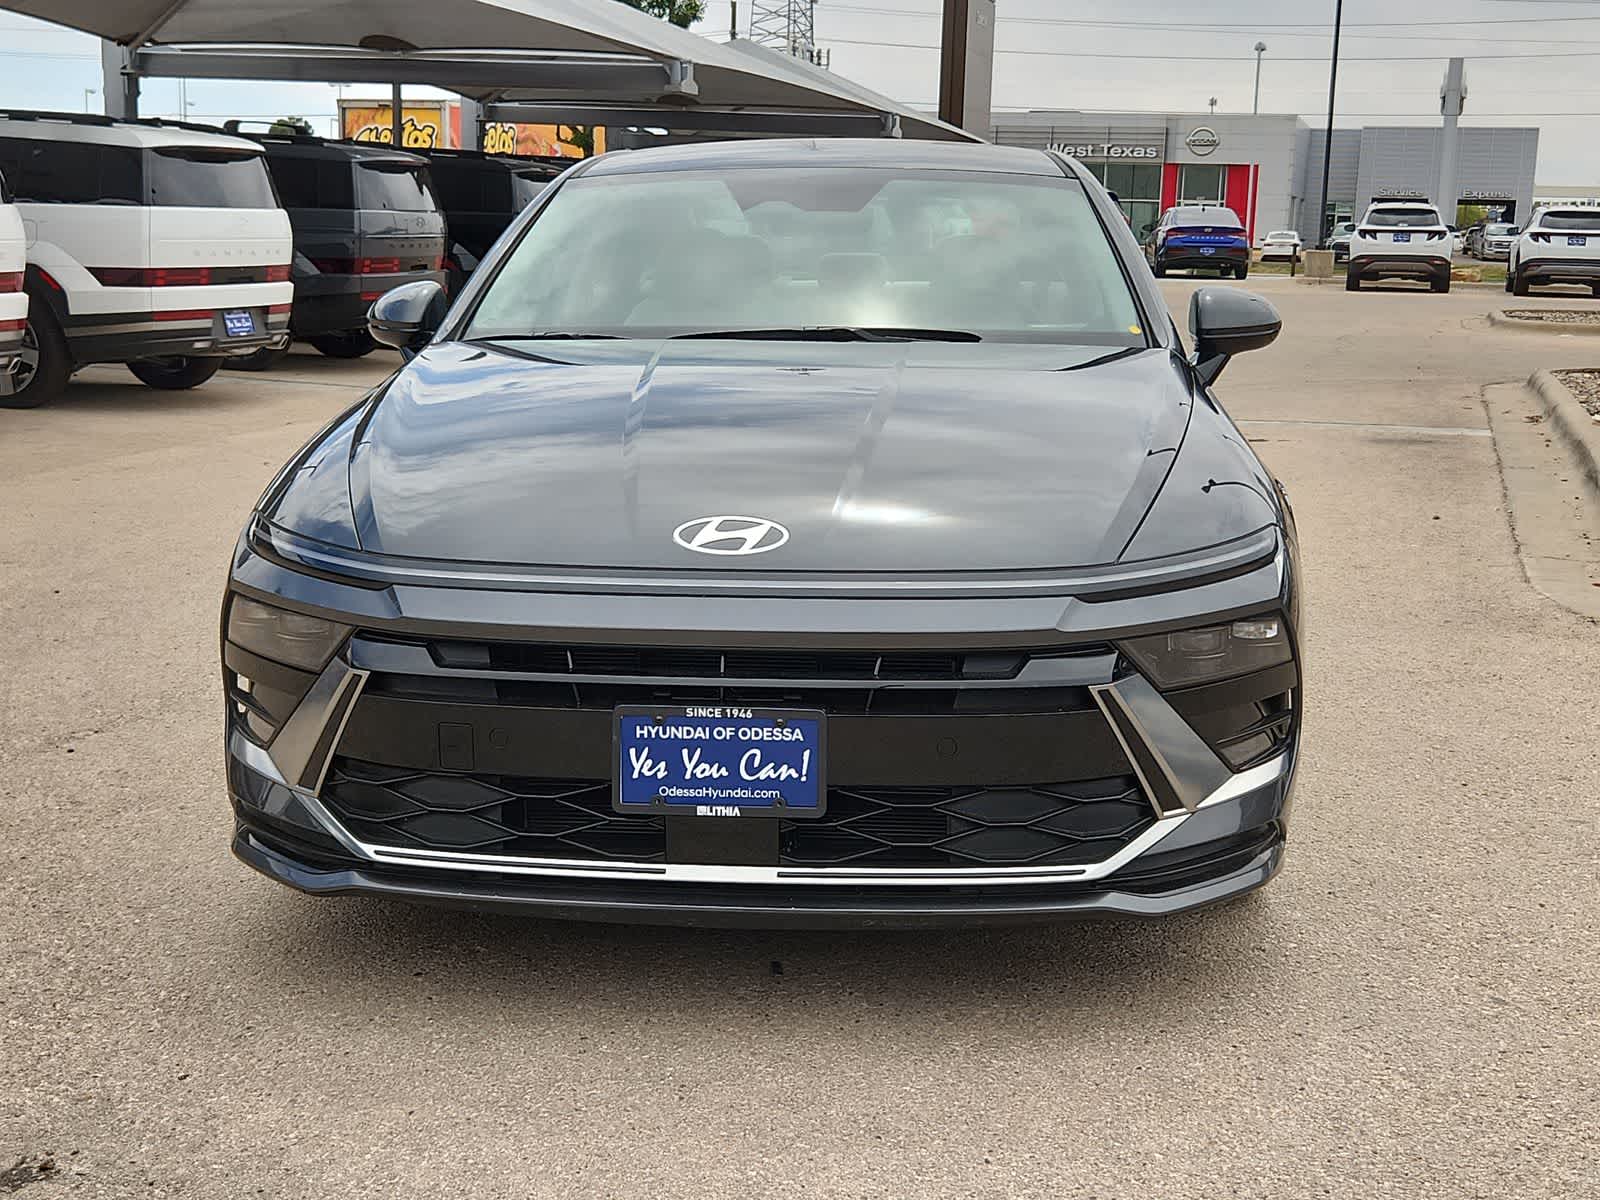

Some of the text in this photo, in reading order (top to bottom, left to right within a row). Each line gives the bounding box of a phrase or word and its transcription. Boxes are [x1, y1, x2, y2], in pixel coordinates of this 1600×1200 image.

[1046, 143, 1158, 159] West Texas
[686, 708, 753, 719] SINCE 1946
[635, 725, 804, 742] HYUNDAI OF ODESSA
[628, 747, 811, 783] Yes You Can!
[658, 785, 781, 800] OdessaHyundai.com
[706, 805, 741, 817] LITHIA
